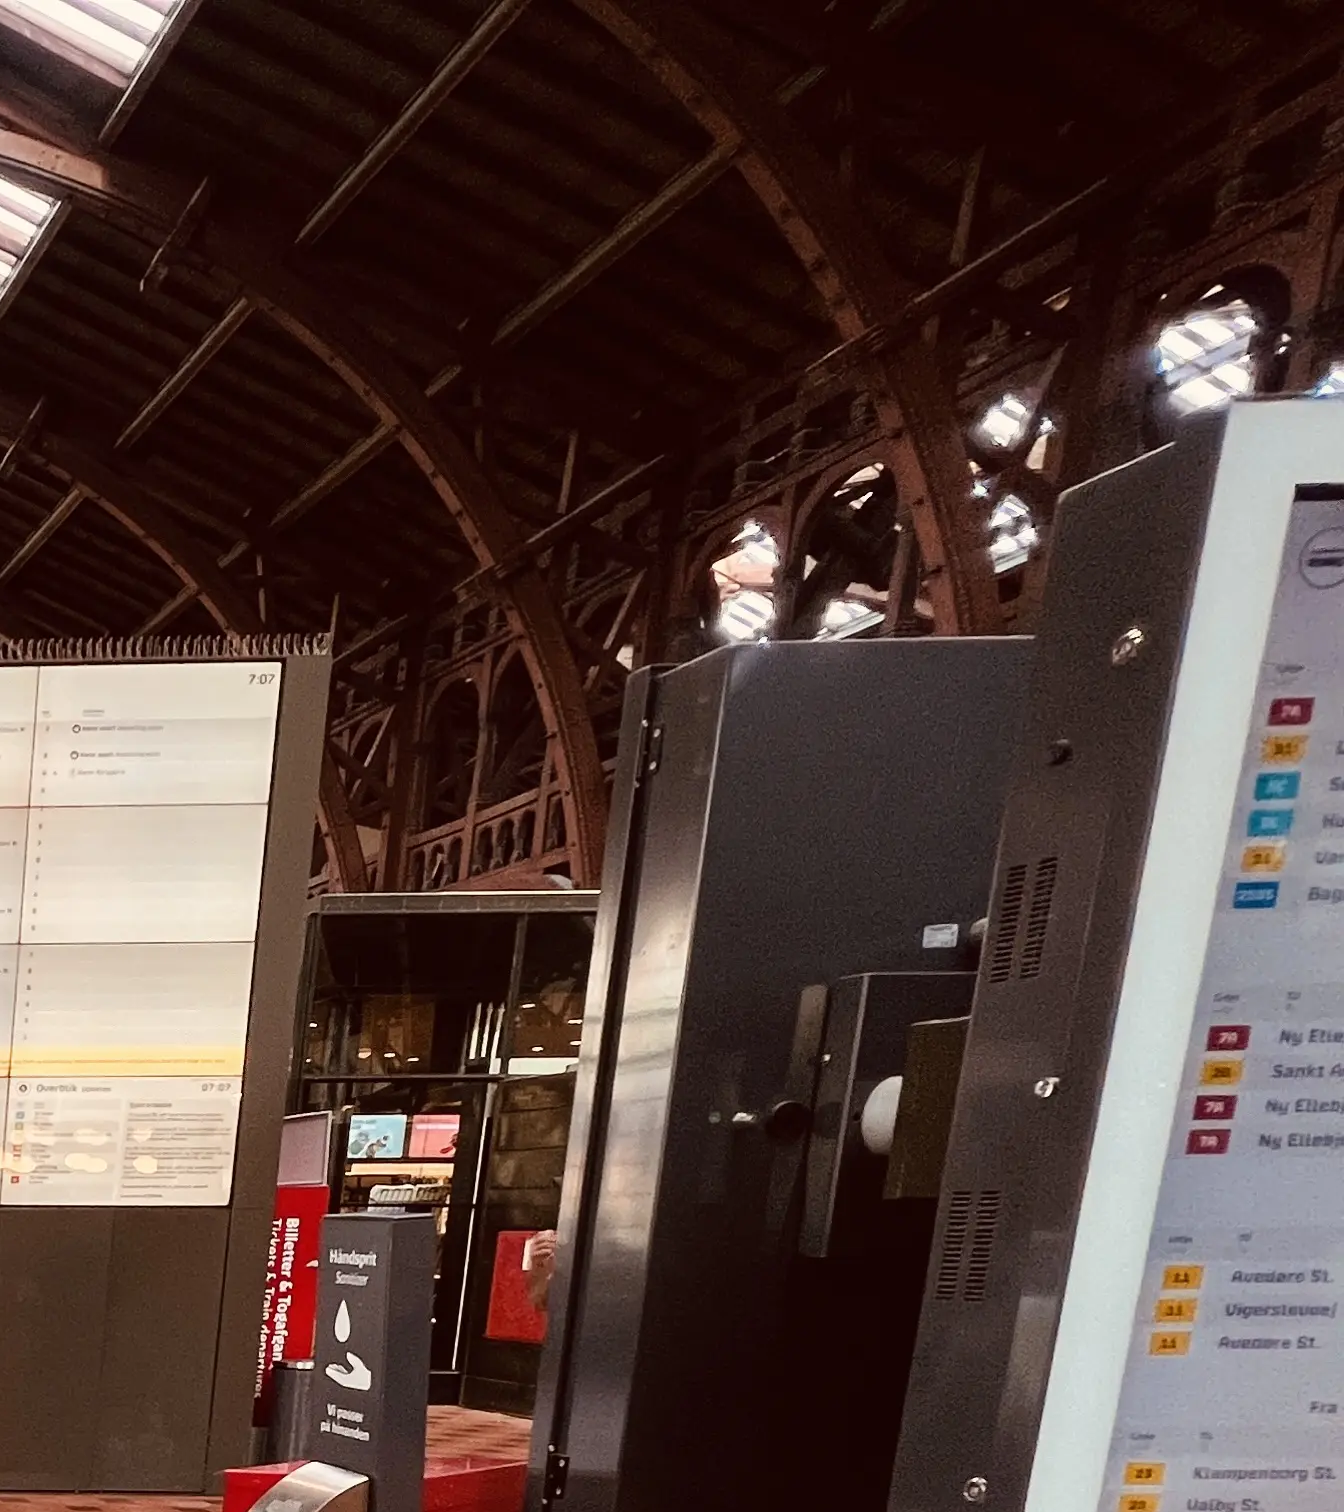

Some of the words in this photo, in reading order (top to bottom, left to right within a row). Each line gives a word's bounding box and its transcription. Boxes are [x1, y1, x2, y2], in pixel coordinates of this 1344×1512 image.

[248, 673, 276, 685] 7:07
[280, 1217, 300, 1277] Billetter
[279, 1281, 293, 1292] &
[269, 1295, 292, 1368] Togafgan
